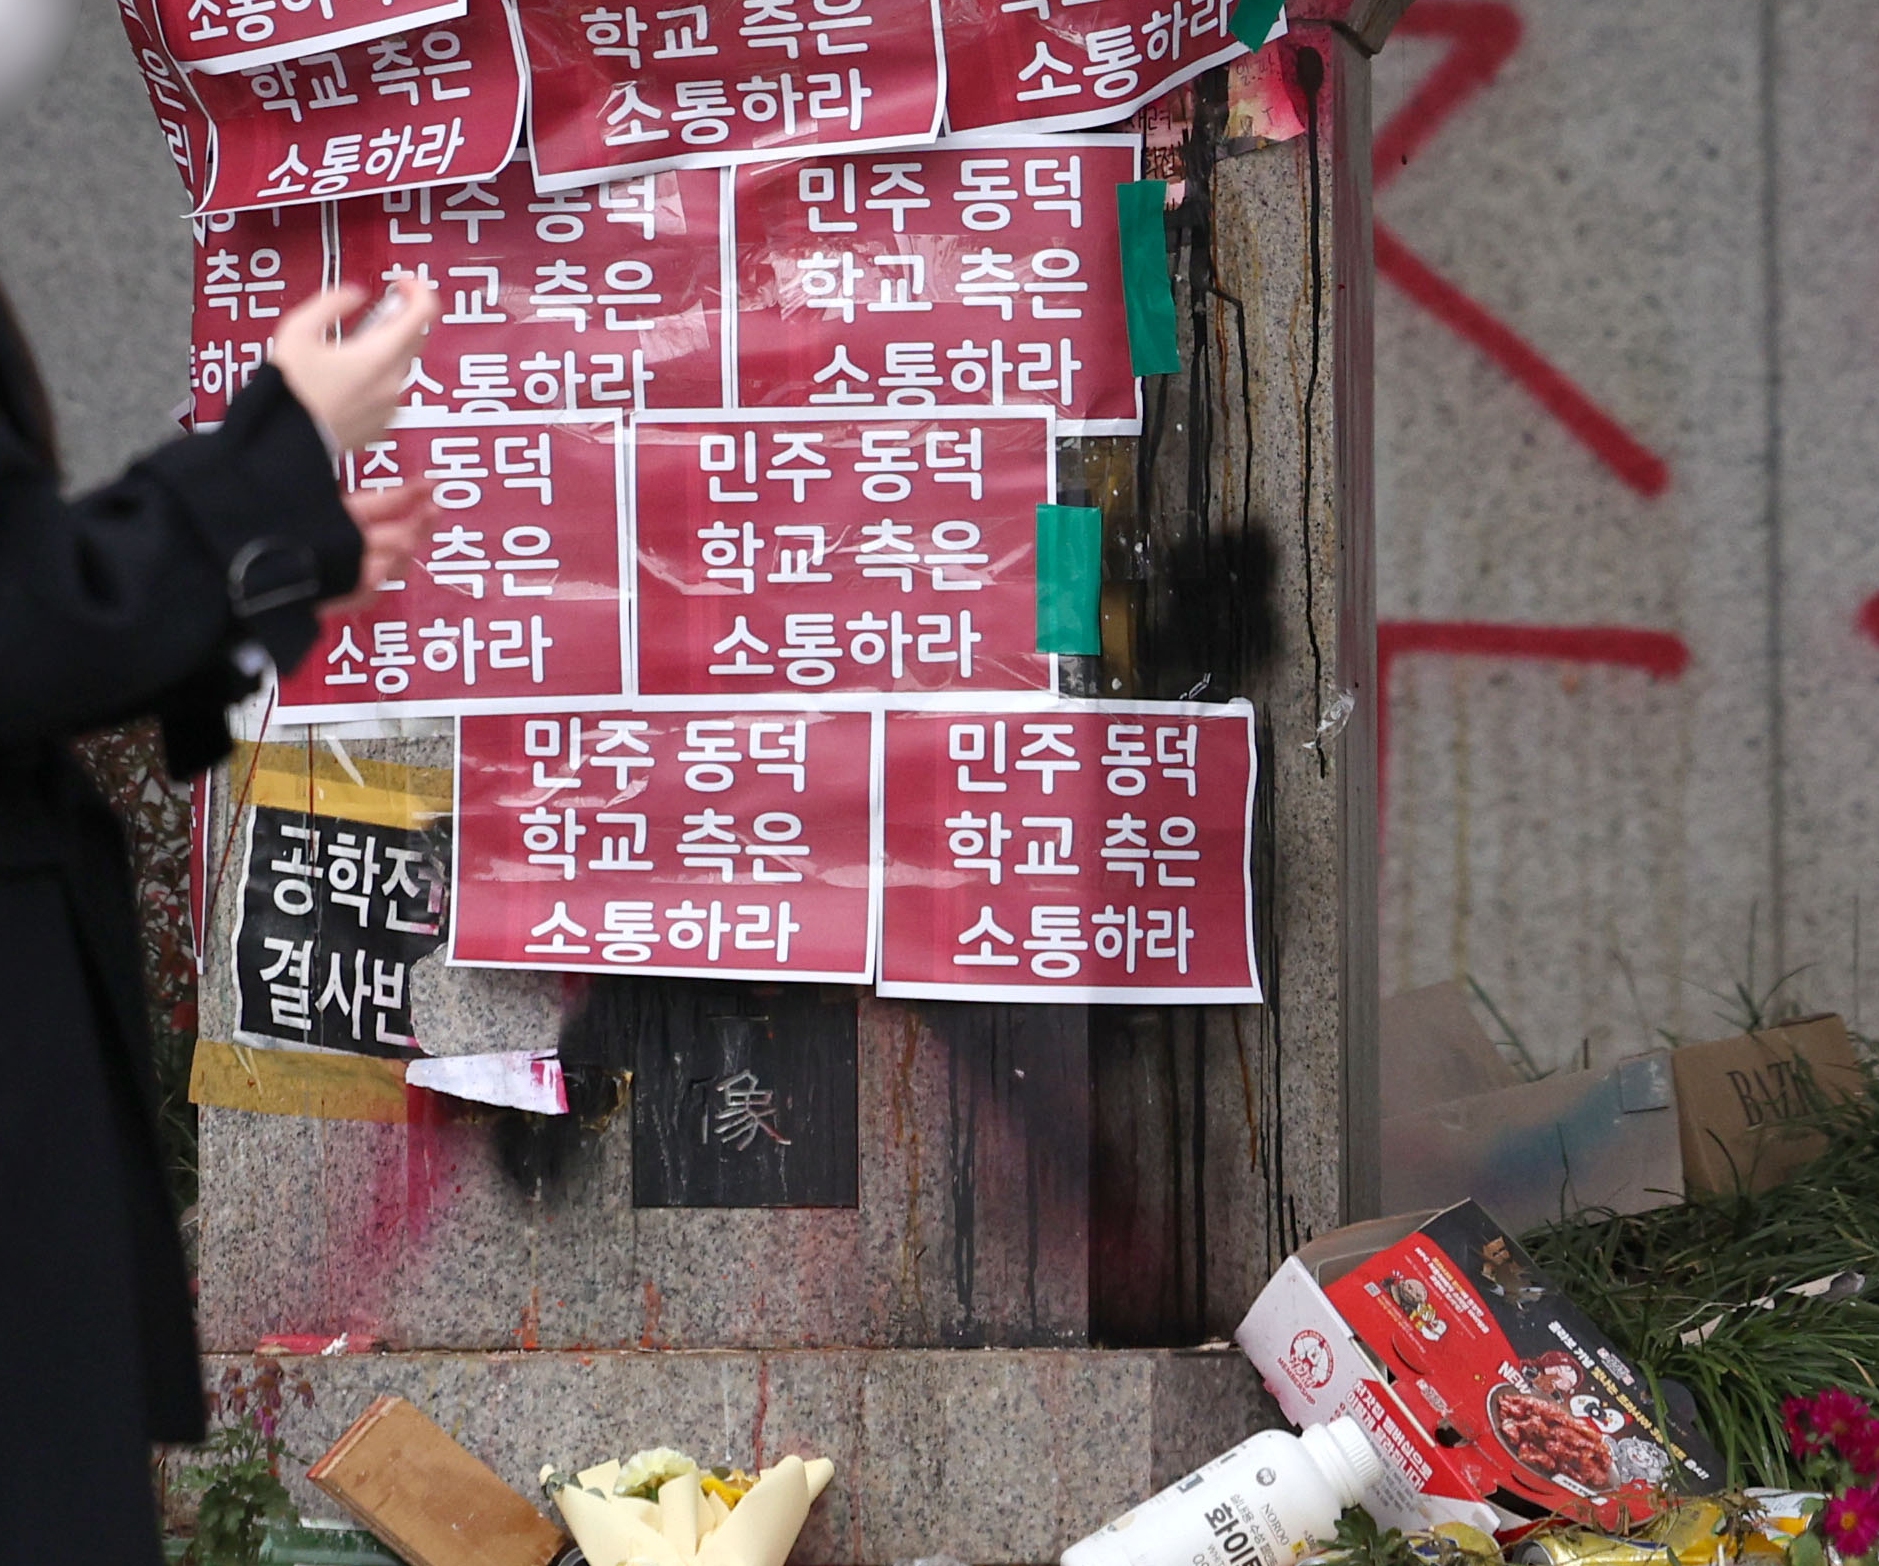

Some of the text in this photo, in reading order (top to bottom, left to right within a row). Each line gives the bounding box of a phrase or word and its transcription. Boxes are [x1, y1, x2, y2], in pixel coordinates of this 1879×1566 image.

[579, 4, 719, 70] 학교
[240, 30, 473, 123] 학교 측은
[604, 67, 873, 147] 소통하라
[257, 116, 465, 199] 소통하라
[798, 161, 931, 233] 민주
[953, 155, 1082, 231] 동덕
[527, 177, 655, 244] 동덕
[203, 247, 286, 322] 측은
[529, 258, 662, 333] 측은
[796, 246, 1089, 323] 학교 측은
[396, 349, 654, 414] 소통하라
[809, 338, 1082, 407] 소통하라
[424, 433, 553, 509] 동덕
[699, 427, 983, 503] 민주 동덕
[426, 525, 559, 598] 측은
[697, 518, 988, 594] 학교 측은
[325, 615, 553, 695] 소통하라
[708, 610, 982, 686] 소통하라
[525, 716, 807, 793] 민주 동덕
[948, 720, 1198, 797] 민주 동덕
[520, 806, 810, 883] 학교 측은
[945, 810, 1201, 888] 학교 측은
[524, 899, 801, 963] 소통하라
[953, 904, 1195, 979] 소통하라
[1497, 1360, 1532, 1395] NEW
[1262, 1503, 1290, 1546] NOROO
